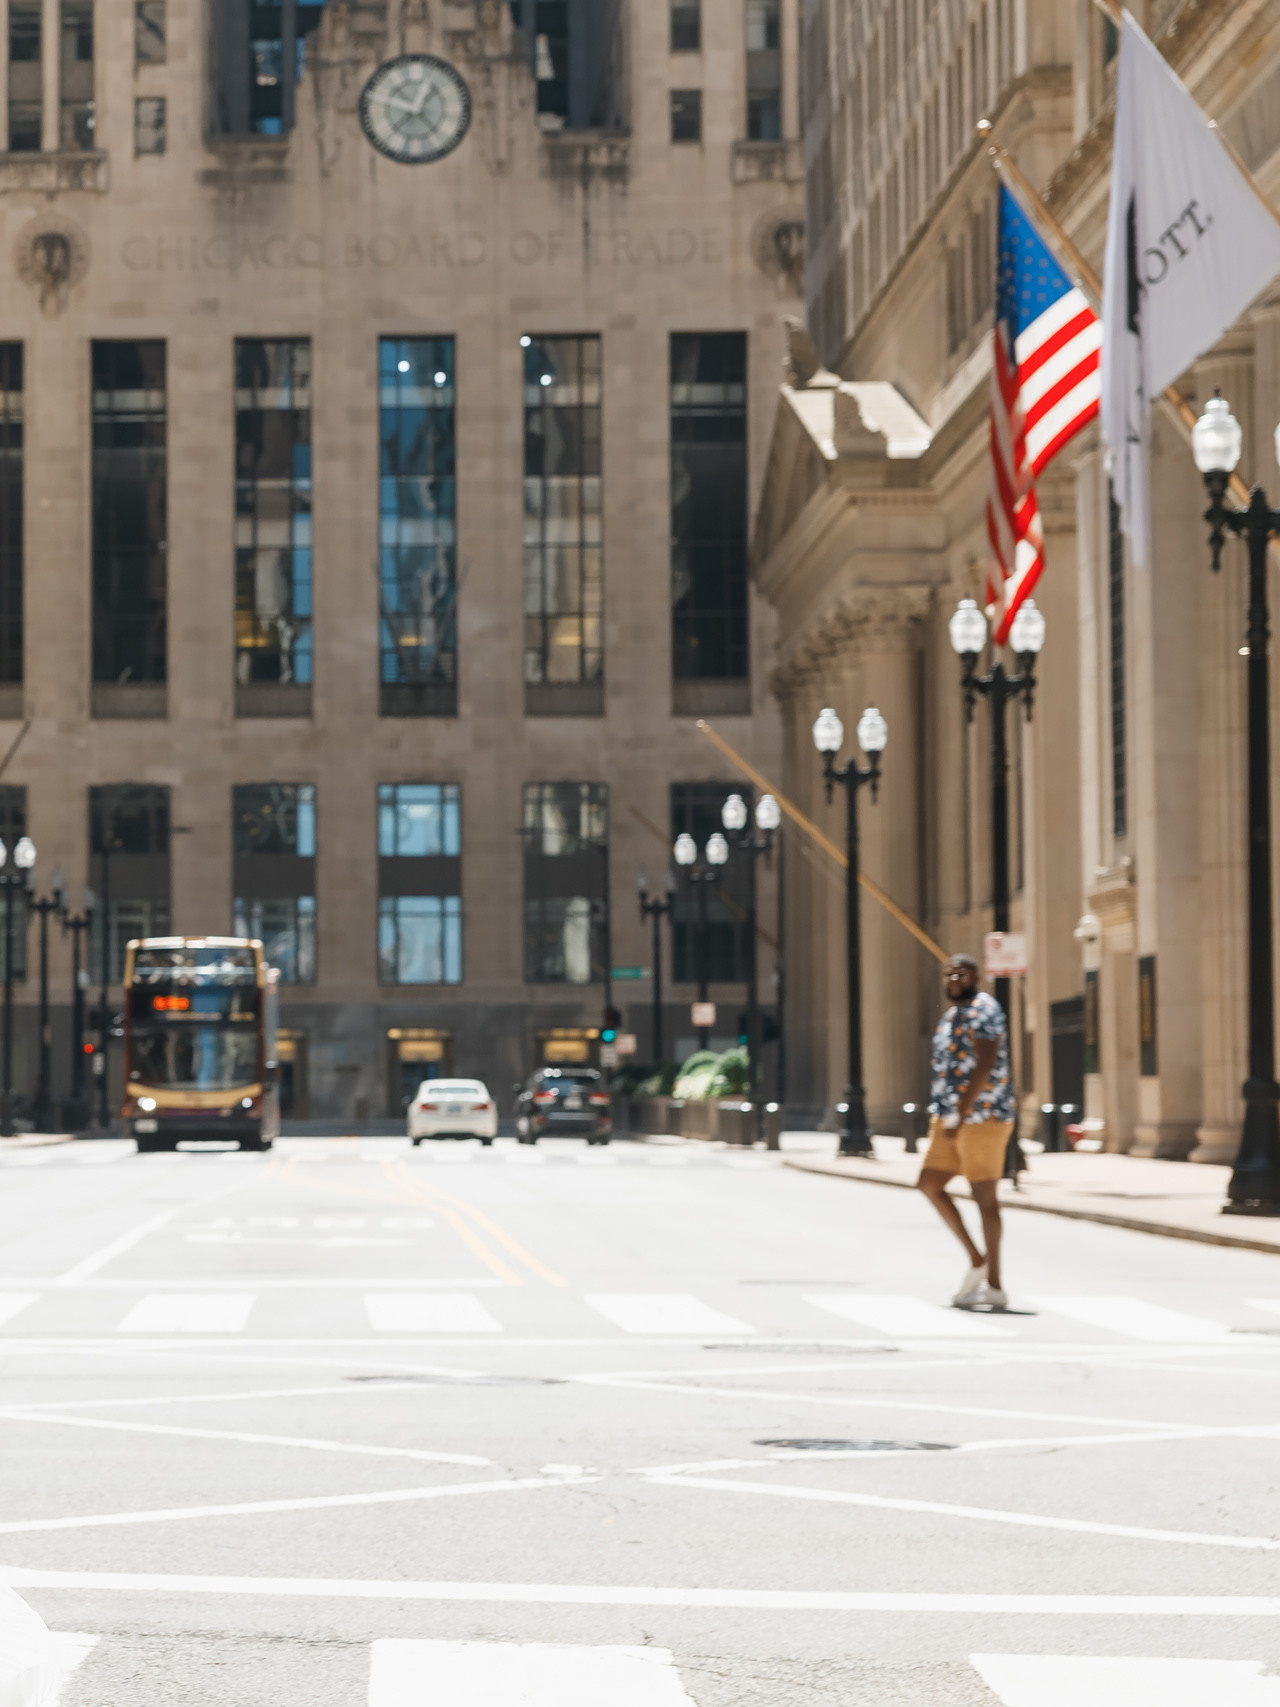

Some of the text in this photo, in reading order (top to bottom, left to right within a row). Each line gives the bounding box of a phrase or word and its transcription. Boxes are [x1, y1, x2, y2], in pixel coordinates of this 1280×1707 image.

[121, 227, 725, 273] CHICAGO BOARD OF TRADE
[1142, 199, 1213, 288] OTT.
